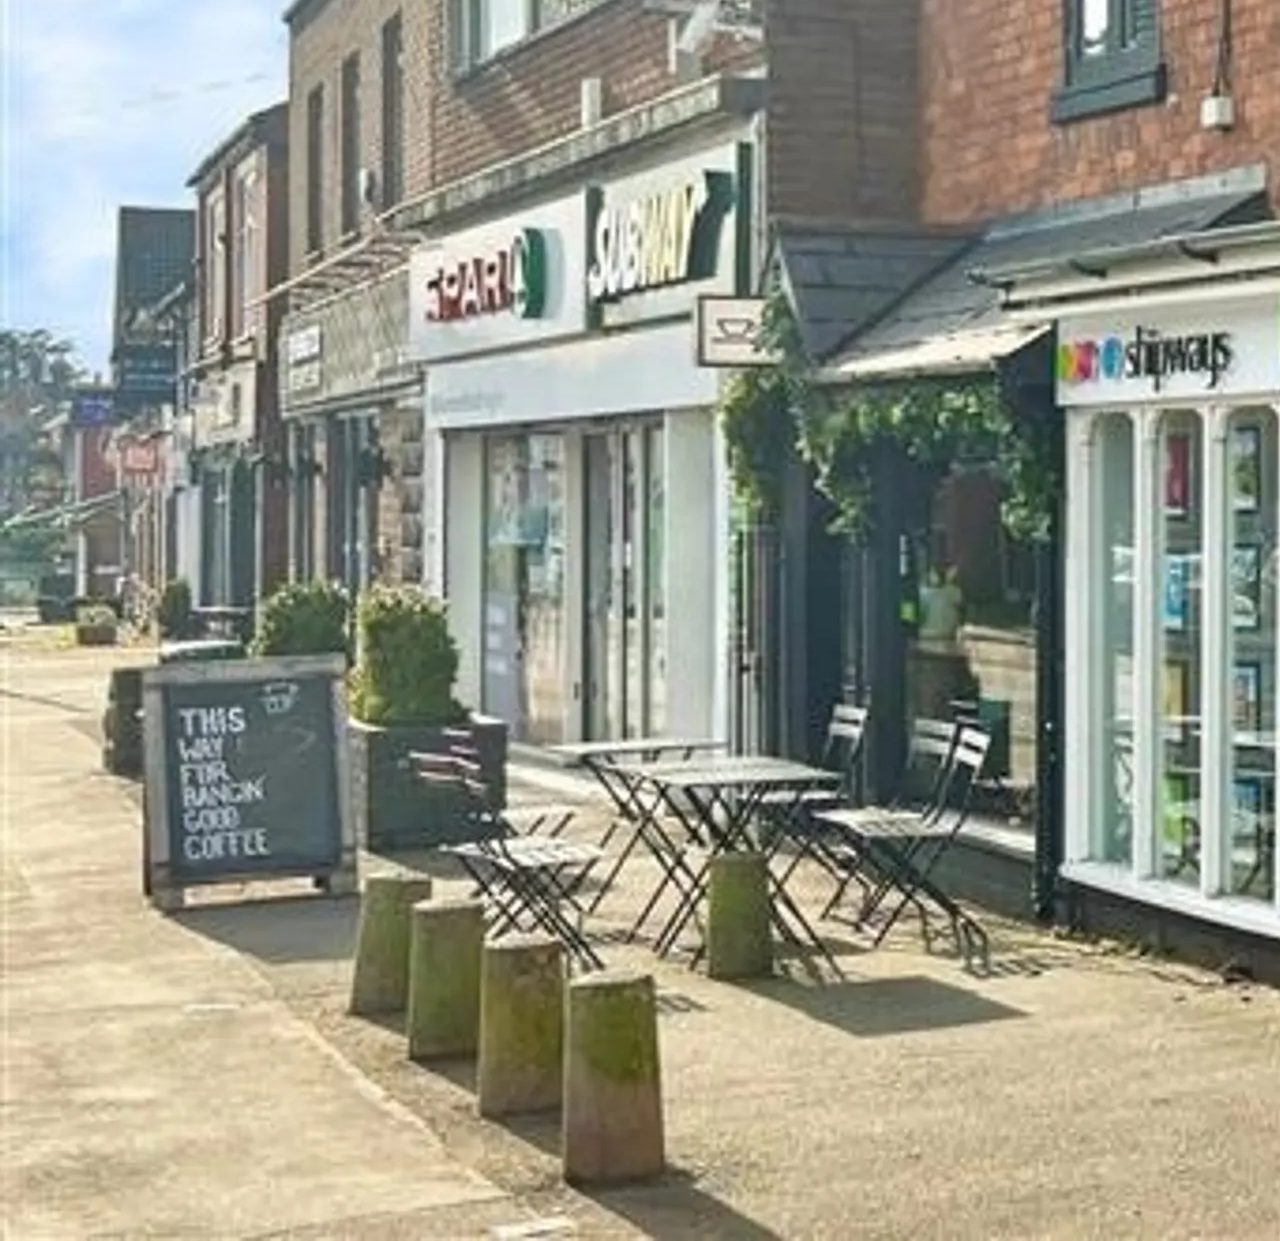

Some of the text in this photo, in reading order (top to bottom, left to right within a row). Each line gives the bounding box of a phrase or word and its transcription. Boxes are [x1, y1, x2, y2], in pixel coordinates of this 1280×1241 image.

[588, 172, 720, 303] SUBWAY
[1125, 325, 1235, 392] shipways
[179, 707, 246, 735] THIS
[177, 737, 224, 762] WAY
[179, 761, 231, 786] FOR
[182, 806, 241, 834] GOOD
[182, 828, 271, 860] COFFEE
